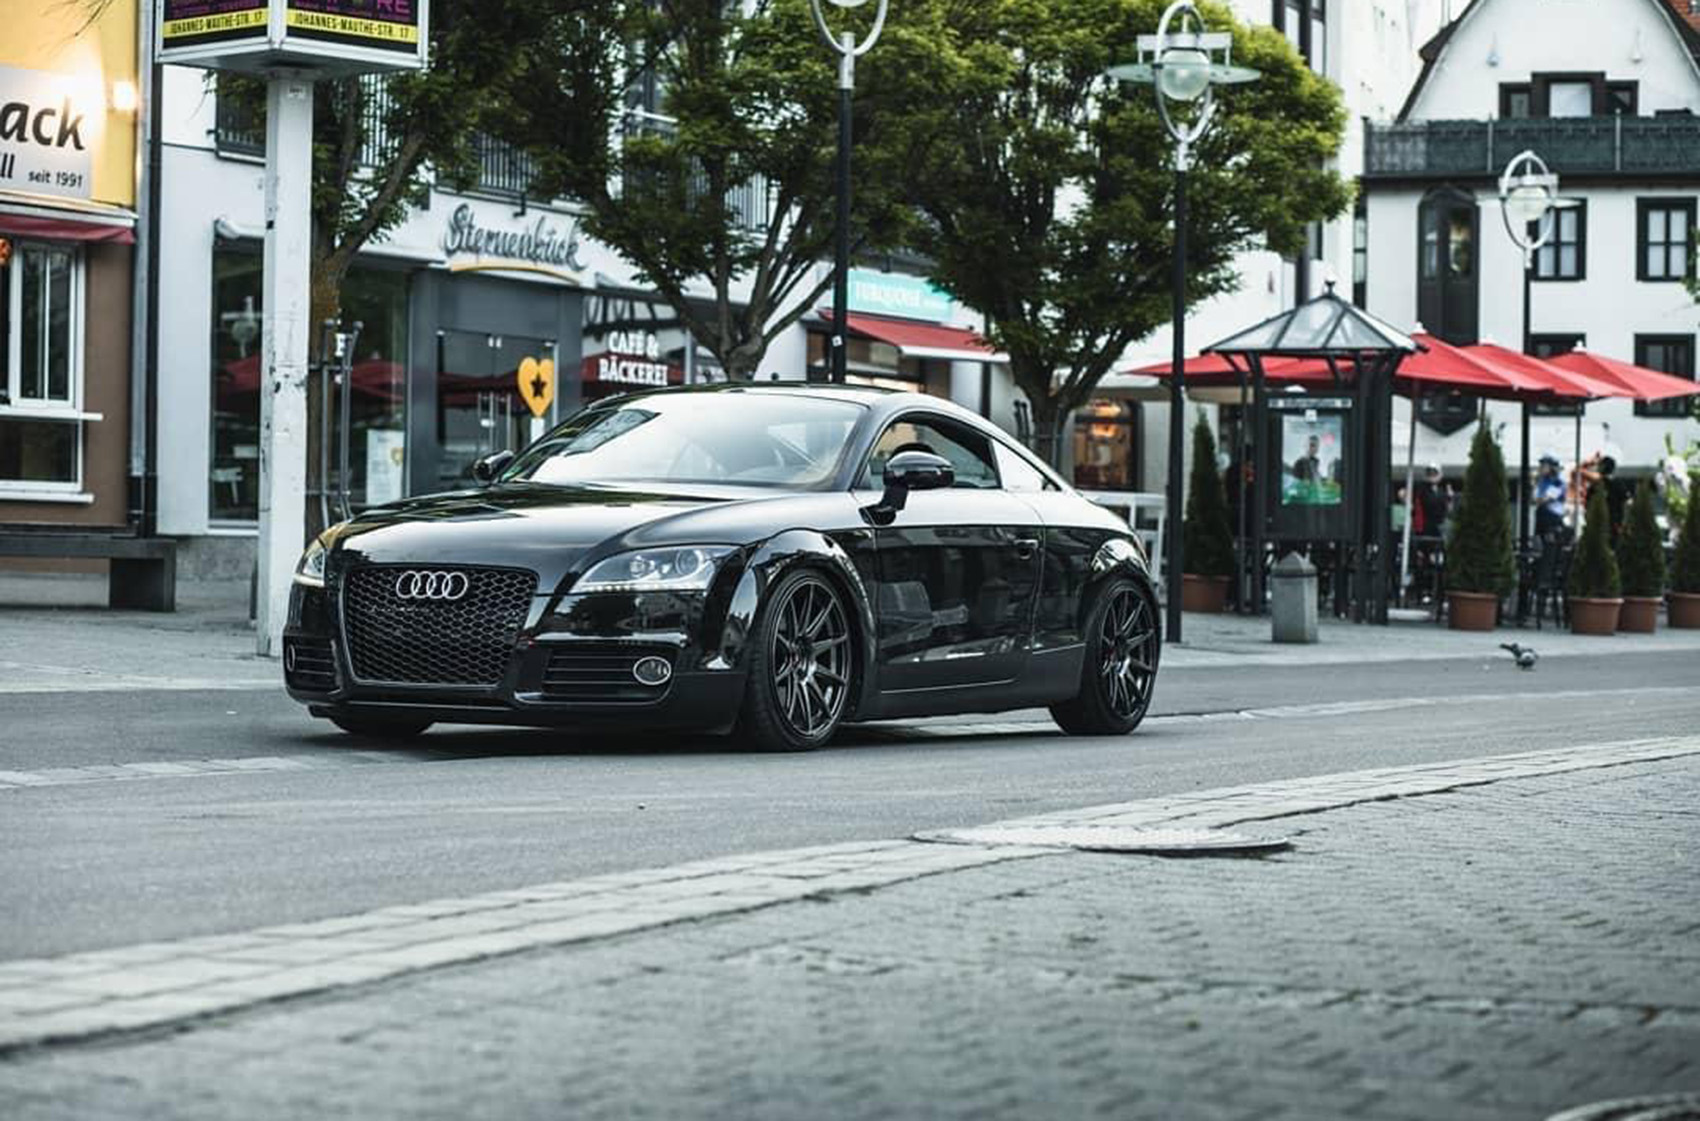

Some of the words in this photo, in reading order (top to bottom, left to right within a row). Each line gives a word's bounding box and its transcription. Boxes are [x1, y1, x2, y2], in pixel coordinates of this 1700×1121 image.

[254, 11, 263, 21] 17
[399, 27, 410, 38] 17
[28, 170, 51, 184] seit
[56, 171, 84, 188] 1991
[608, 330, 645, 356] CAFÉ
[647, 333, 660, 358] &
[598, 355, 669, 387] BÄCKEREI
